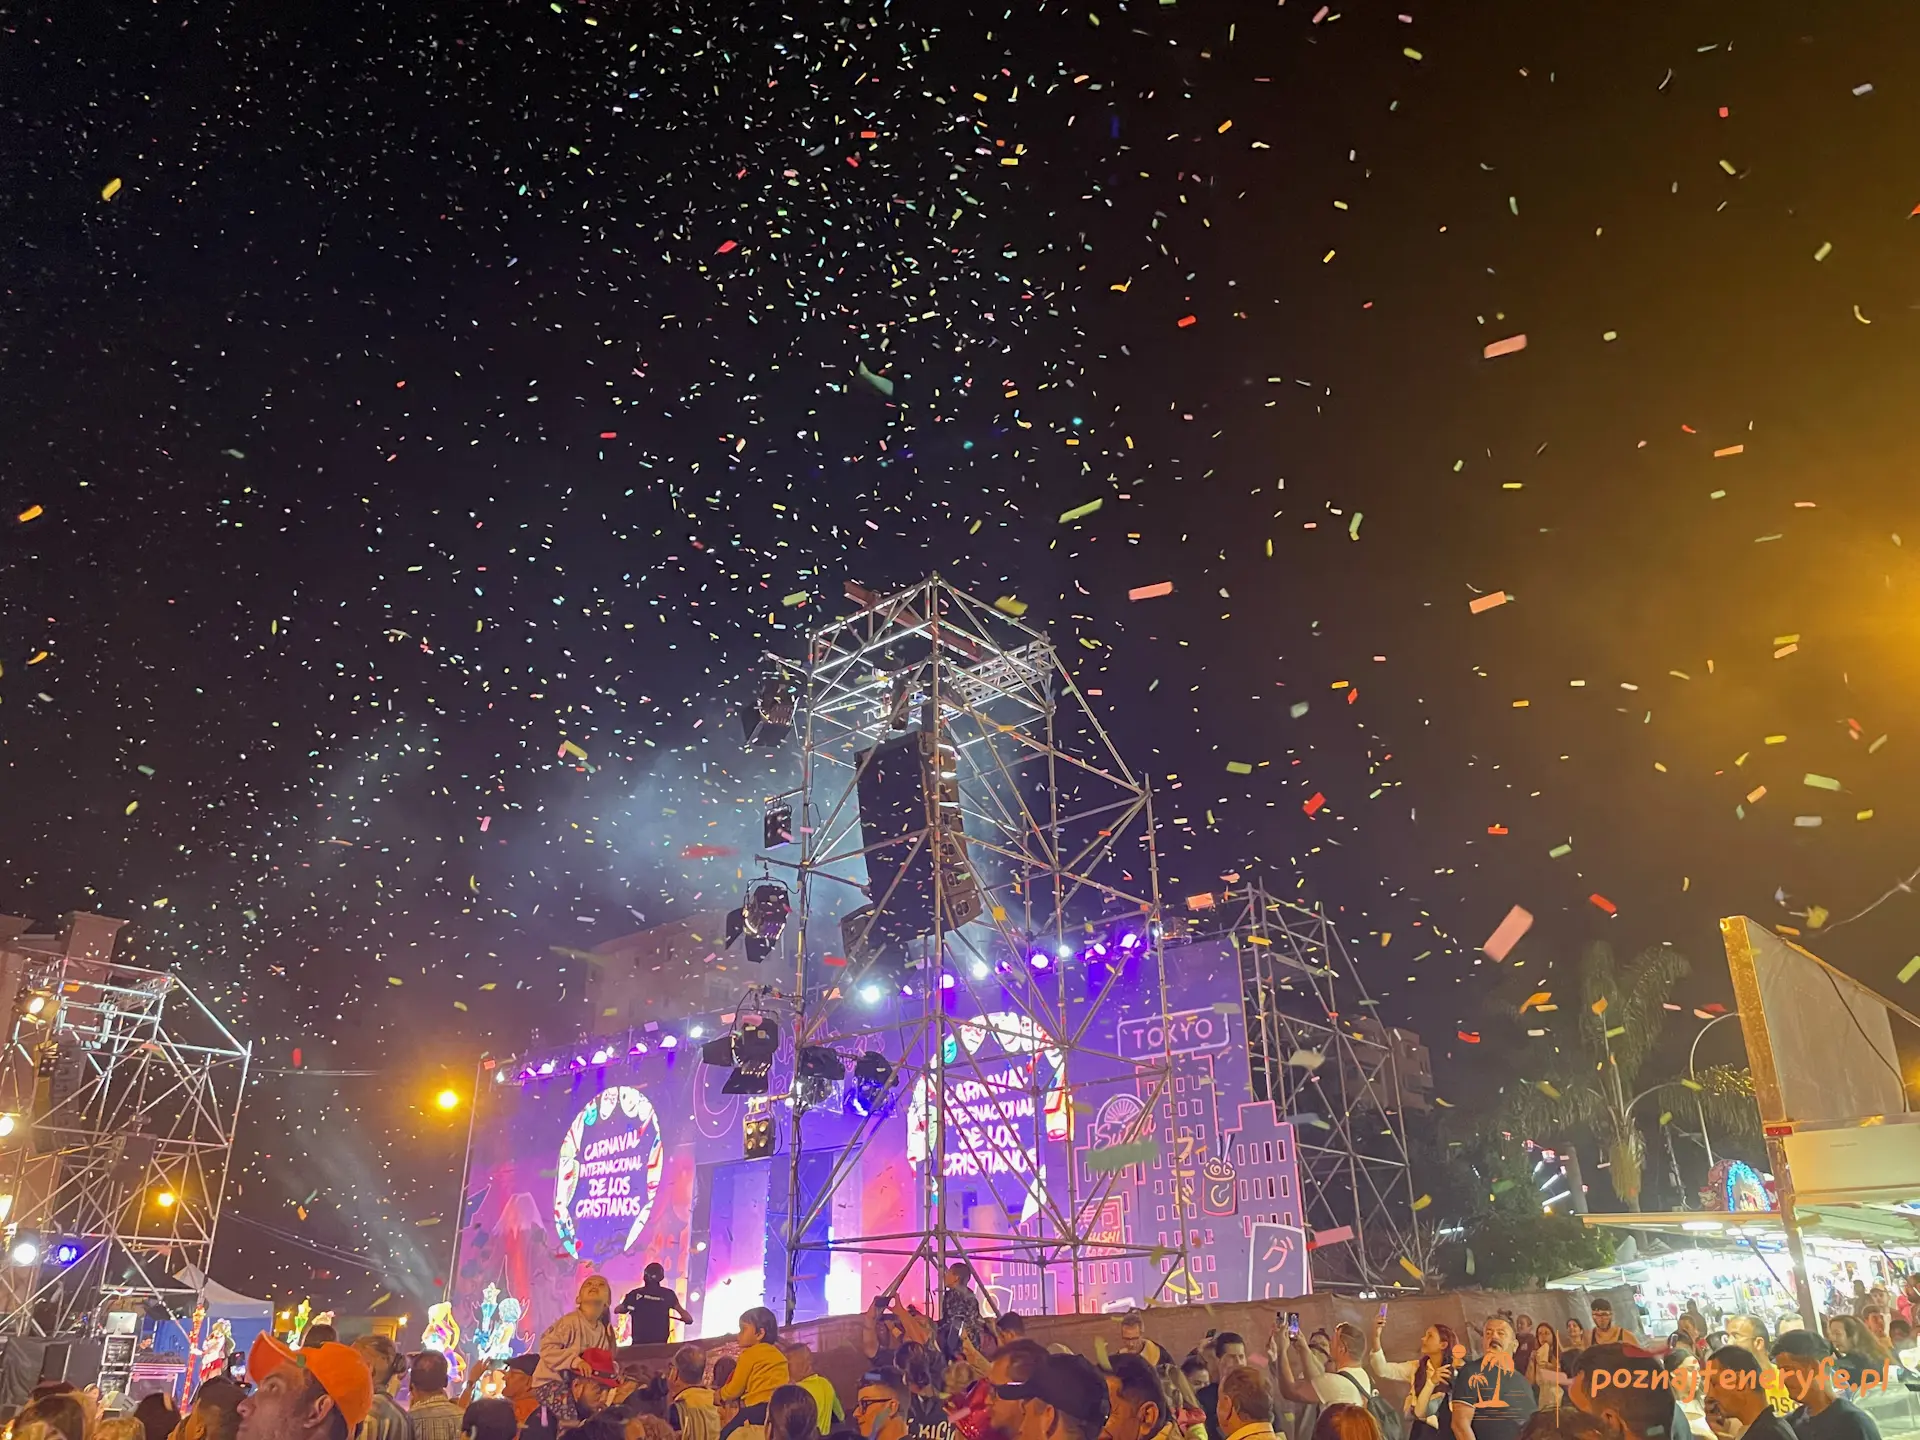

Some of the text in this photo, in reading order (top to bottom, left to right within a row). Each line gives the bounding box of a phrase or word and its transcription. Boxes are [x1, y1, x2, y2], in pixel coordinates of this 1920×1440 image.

[1132, 1018, 1213, 1049] TOKYO
[584, 1129, 640, 1161] CARNAVAL
[580, 1155, 643, 1178] INTERNACIONAL
[588, 1176, 631, 1197] DE LOS
[575, 1196, 641, 1218] CRISTIANOS
